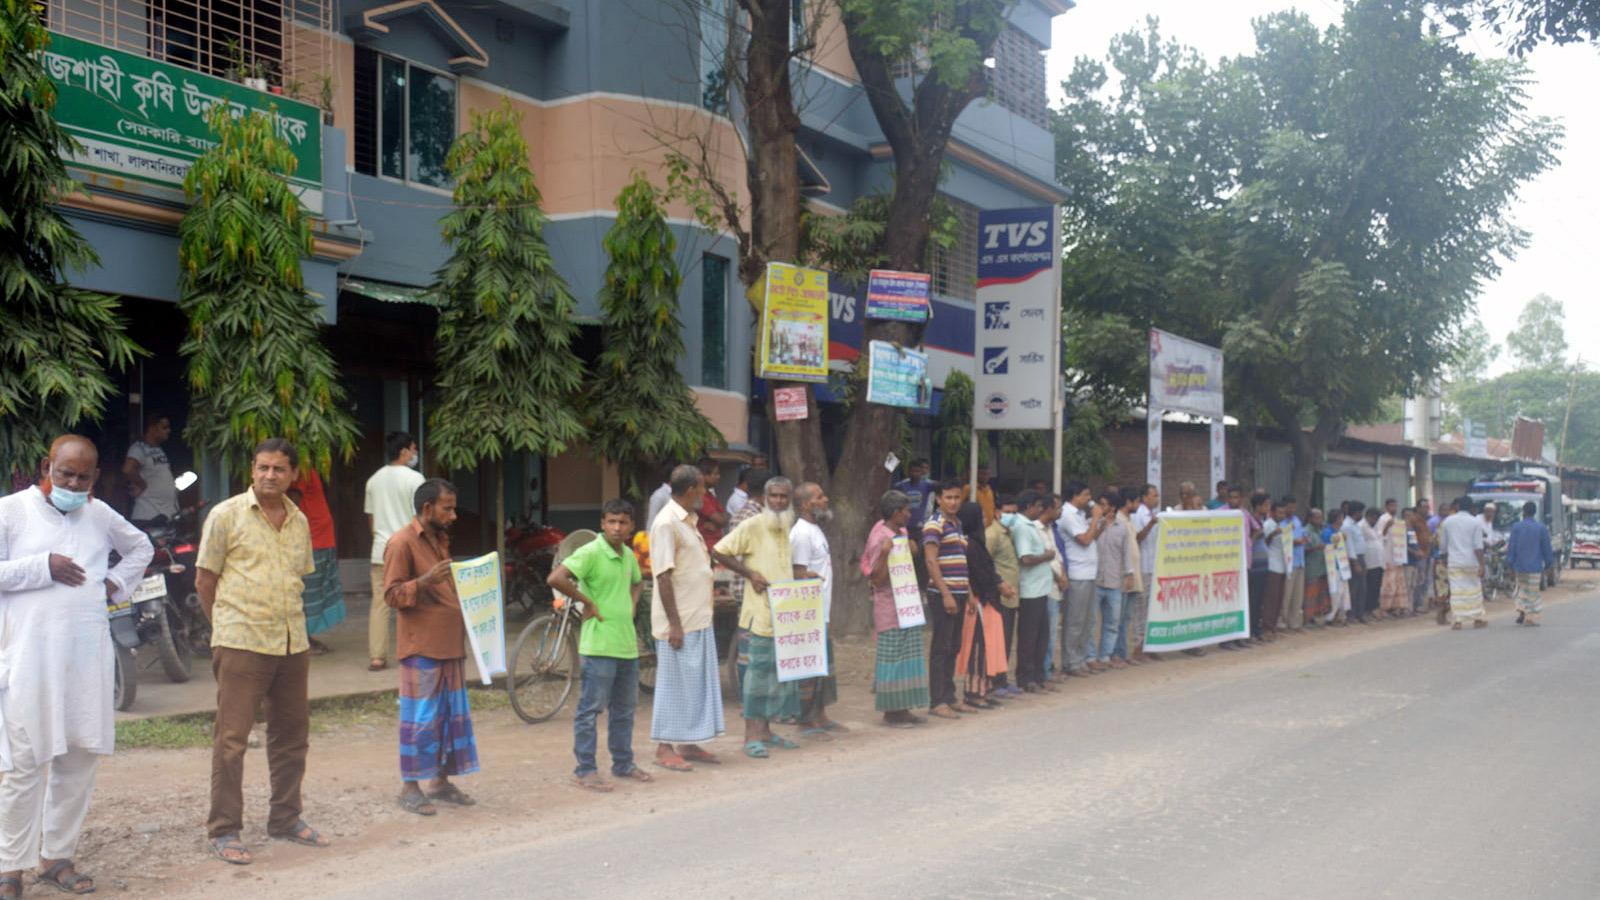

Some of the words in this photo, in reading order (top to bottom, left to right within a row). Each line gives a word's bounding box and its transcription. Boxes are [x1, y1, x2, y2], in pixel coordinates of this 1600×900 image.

[129, 70, 177, 119] কৃষি
[181, 78, 247, 124] উন্নন
[127, 154, 191, 179] লালমনিরহা
[984, 221, 1048, 250] TVS
[776, 611, 801, 625] ব্যাংক
[803, 609, 817, 621] এর
